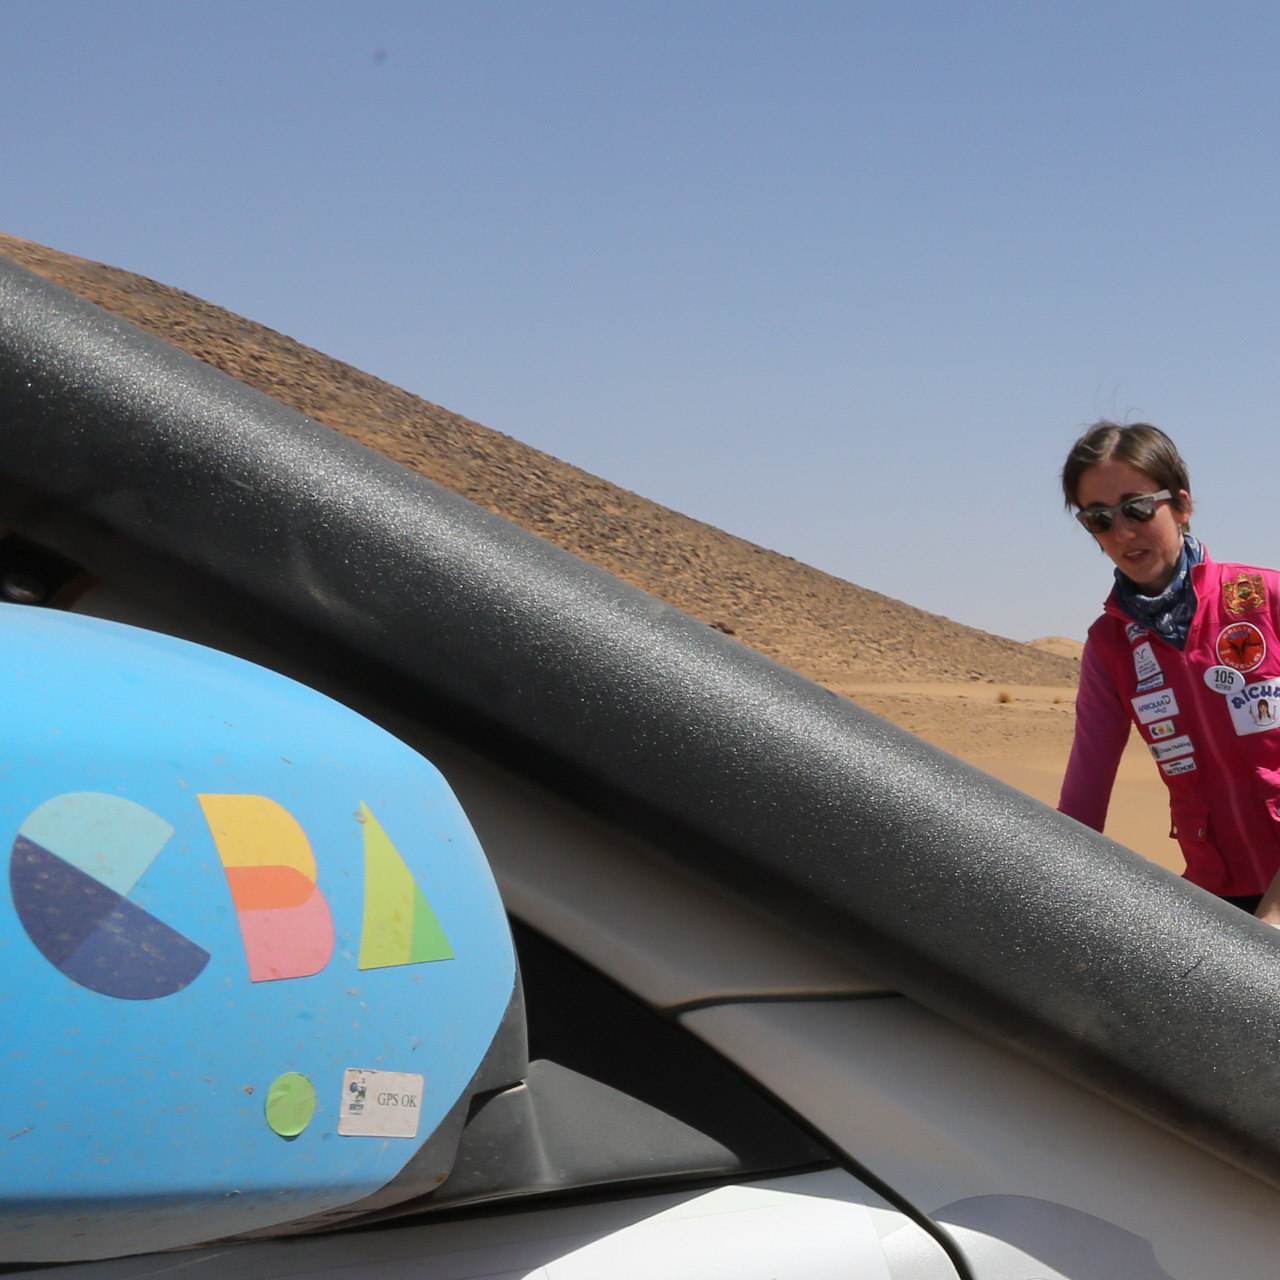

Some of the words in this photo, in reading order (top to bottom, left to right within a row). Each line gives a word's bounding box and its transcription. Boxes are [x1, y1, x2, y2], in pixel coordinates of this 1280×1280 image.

[1214, 670, 1234, 685] 105
[377, 1092, 400, 1107] GPS
[401, 1094, 417, 1108] OK
